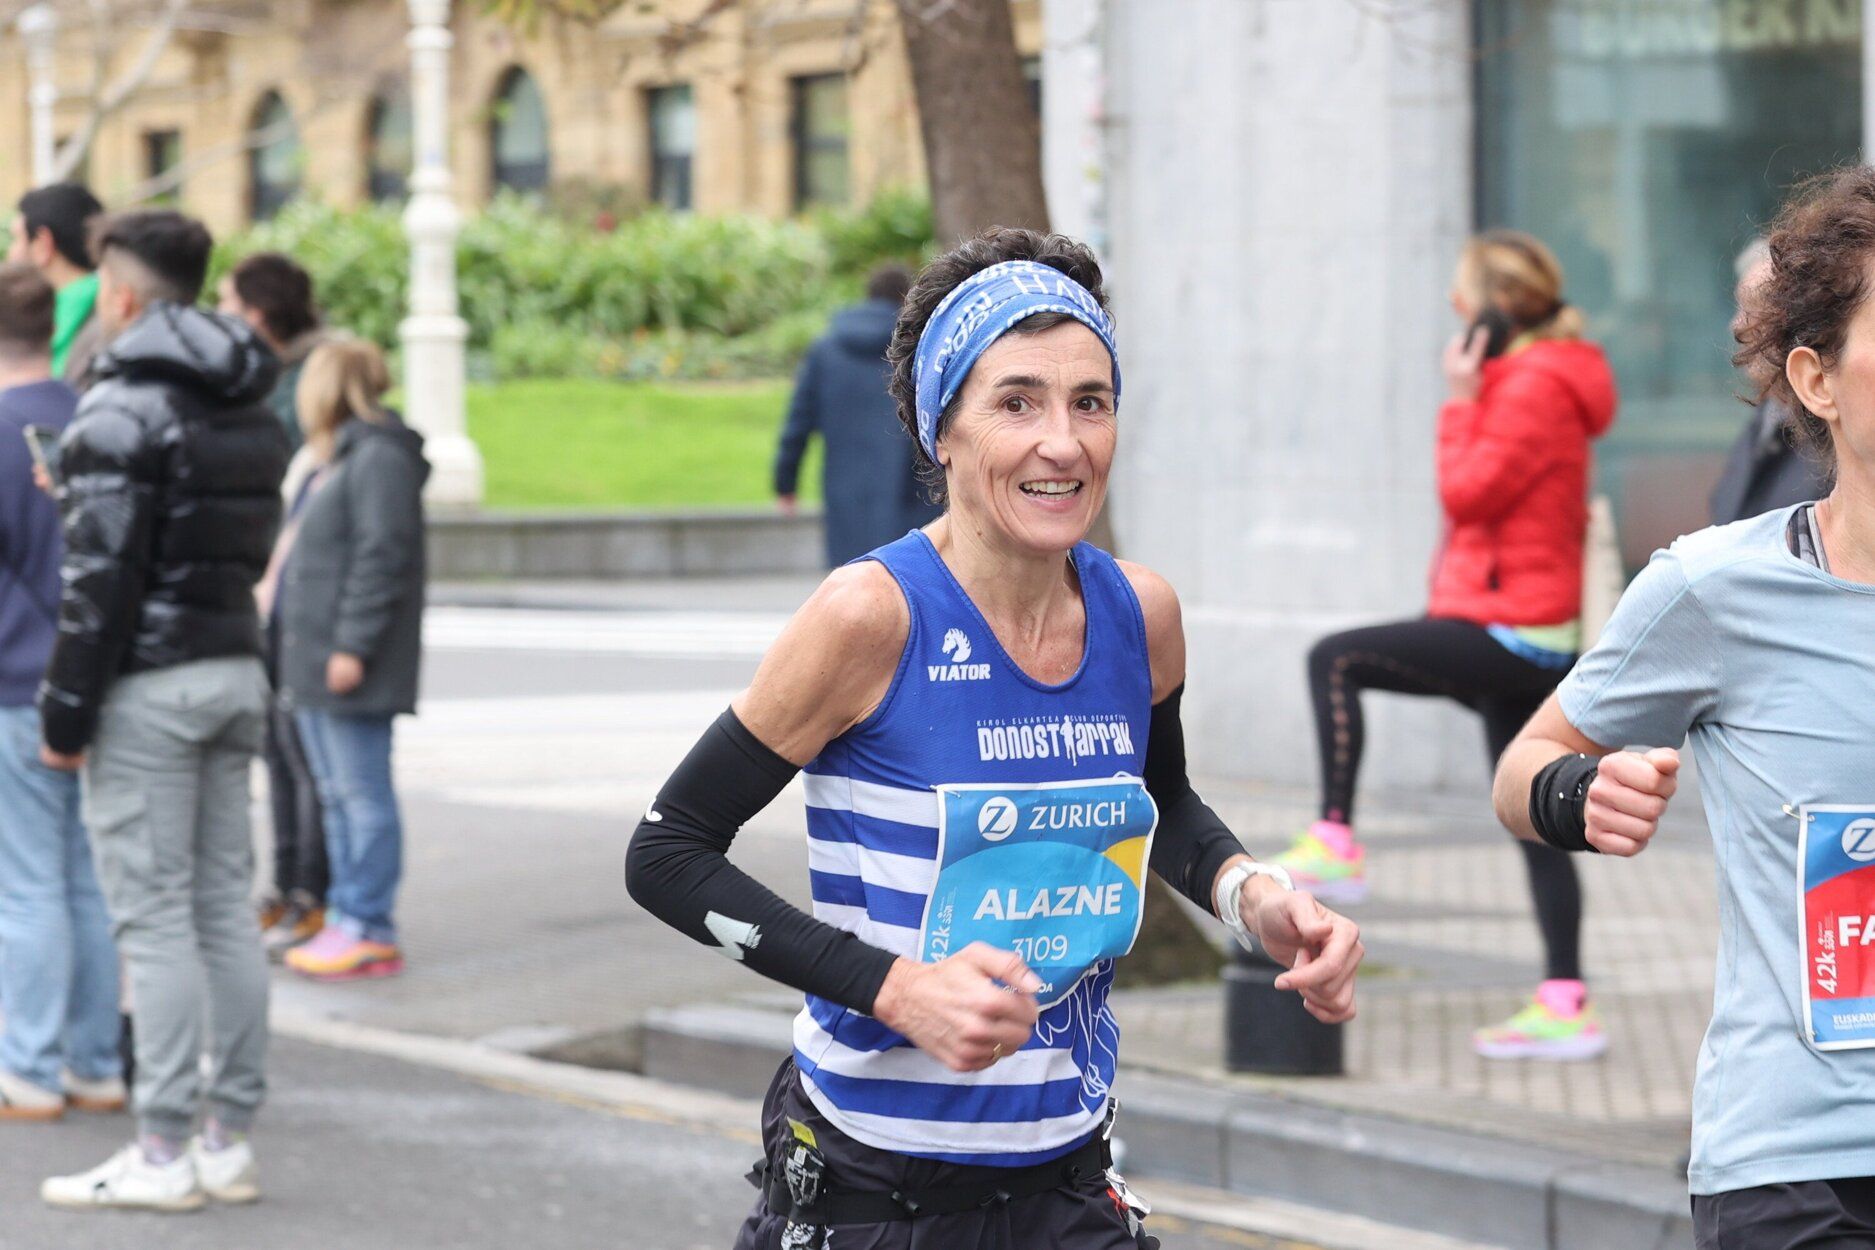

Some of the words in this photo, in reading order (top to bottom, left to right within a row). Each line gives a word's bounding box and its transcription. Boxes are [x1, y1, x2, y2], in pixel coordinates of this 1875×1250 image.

[928, 663, 991, 682] VIATOR
[976, 719, 1006, 727] KIROL
[1012, 715, 1060, 725] ELKARTEA
[1028, 801, 1126, 830] ZURICH
[972, 882, 1123, 921] ALAZNE
[1011, 935, 1068, 962] 3109
[1815, 950, 1838, 995] 42k
